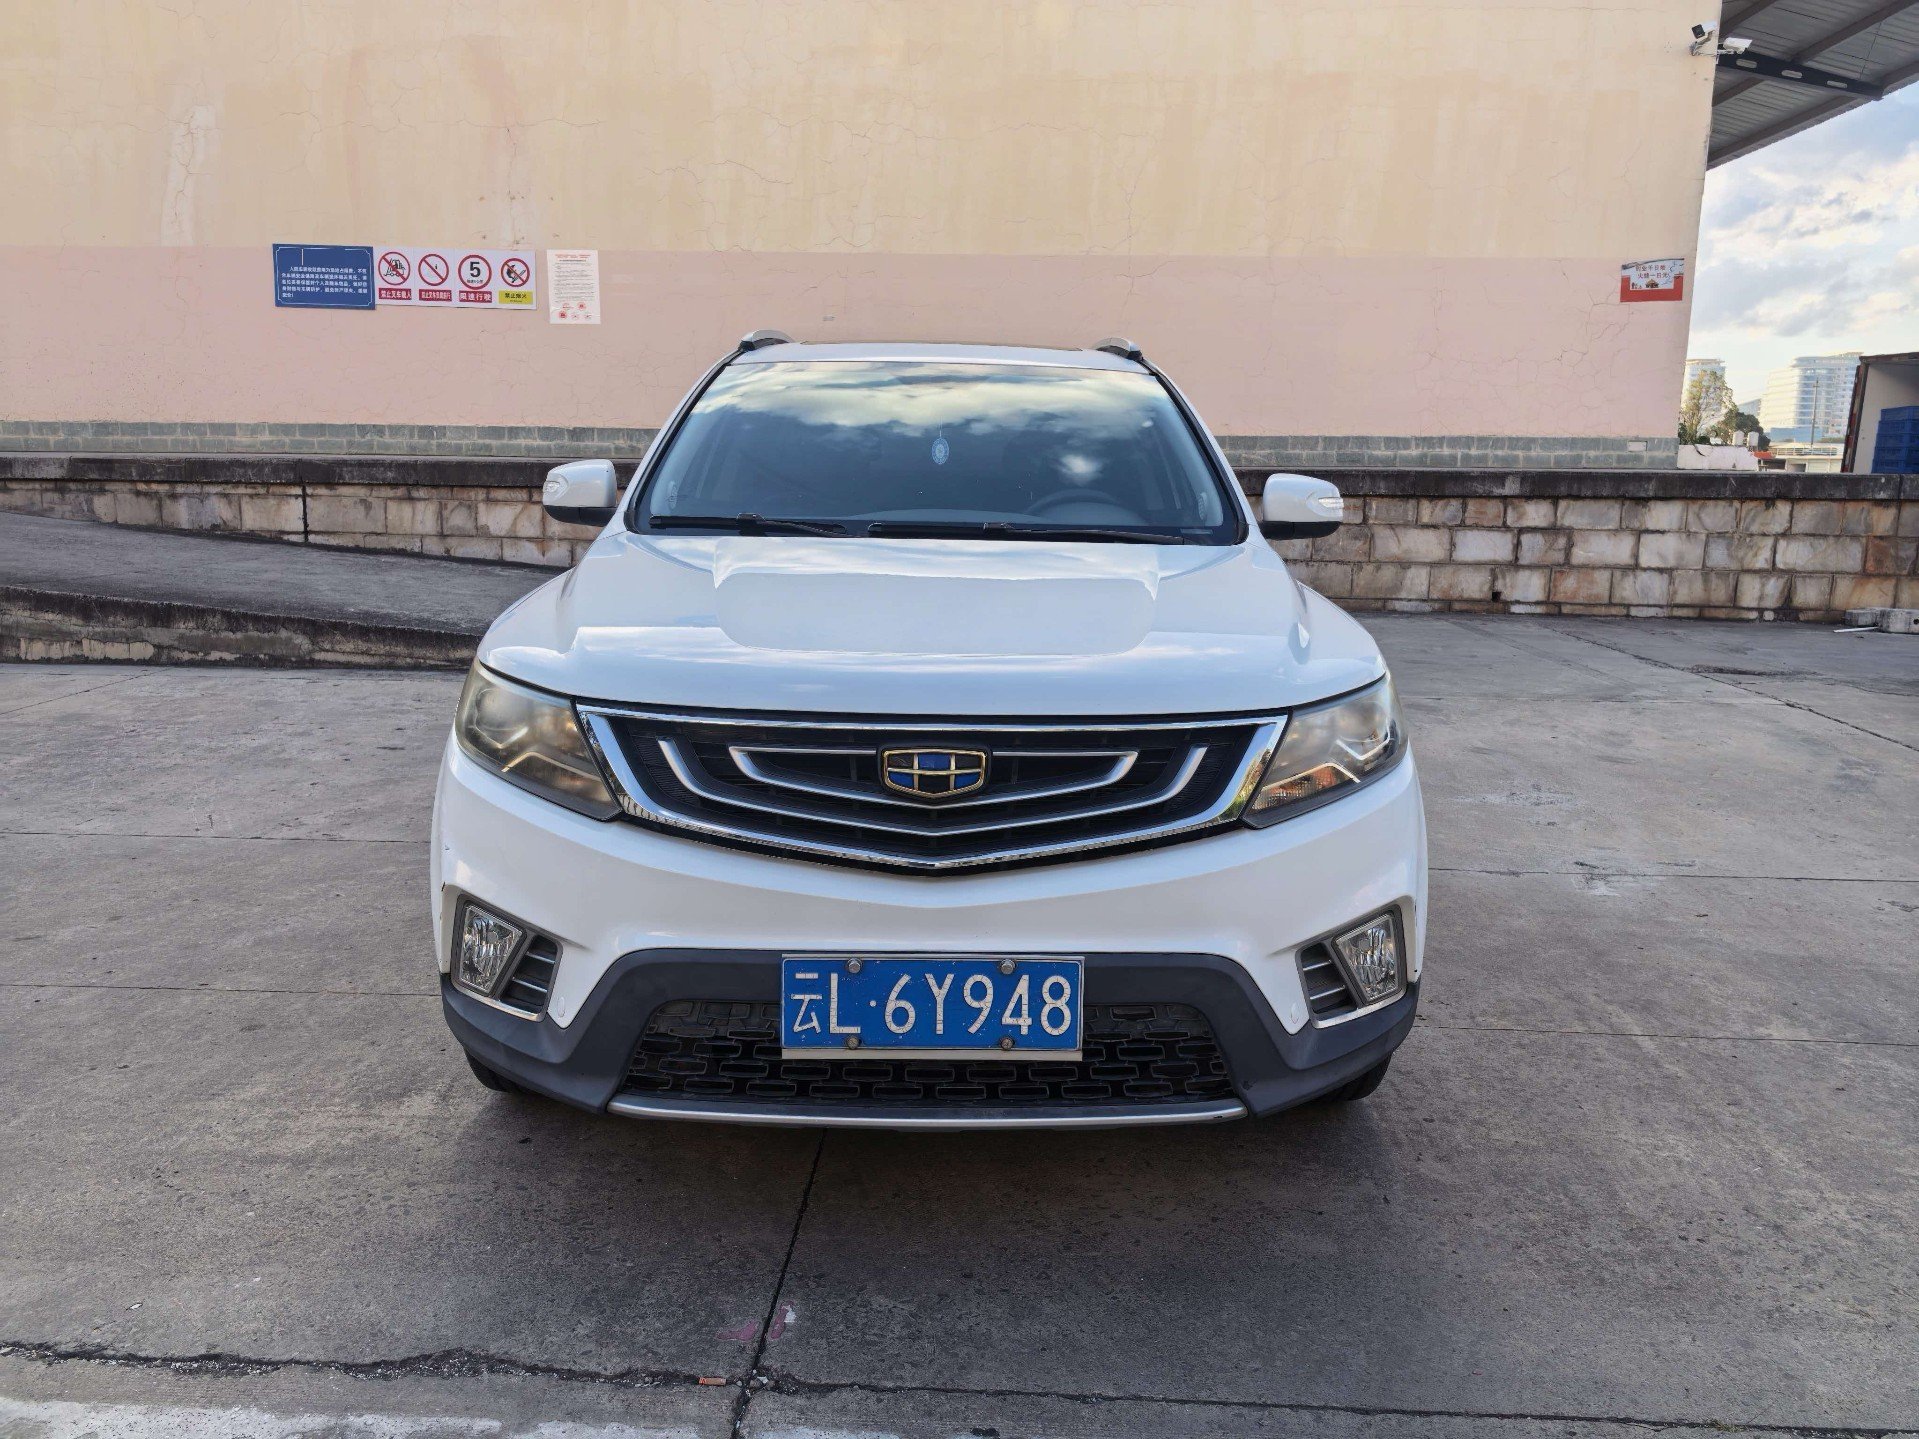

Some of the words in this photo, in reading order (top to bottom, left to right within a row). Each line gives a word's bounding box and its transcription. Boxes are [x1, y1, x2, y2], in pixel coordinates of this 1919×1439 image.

[470, 261, 481, 278] 5
[460, 292, 491, 301] 限速行驶
